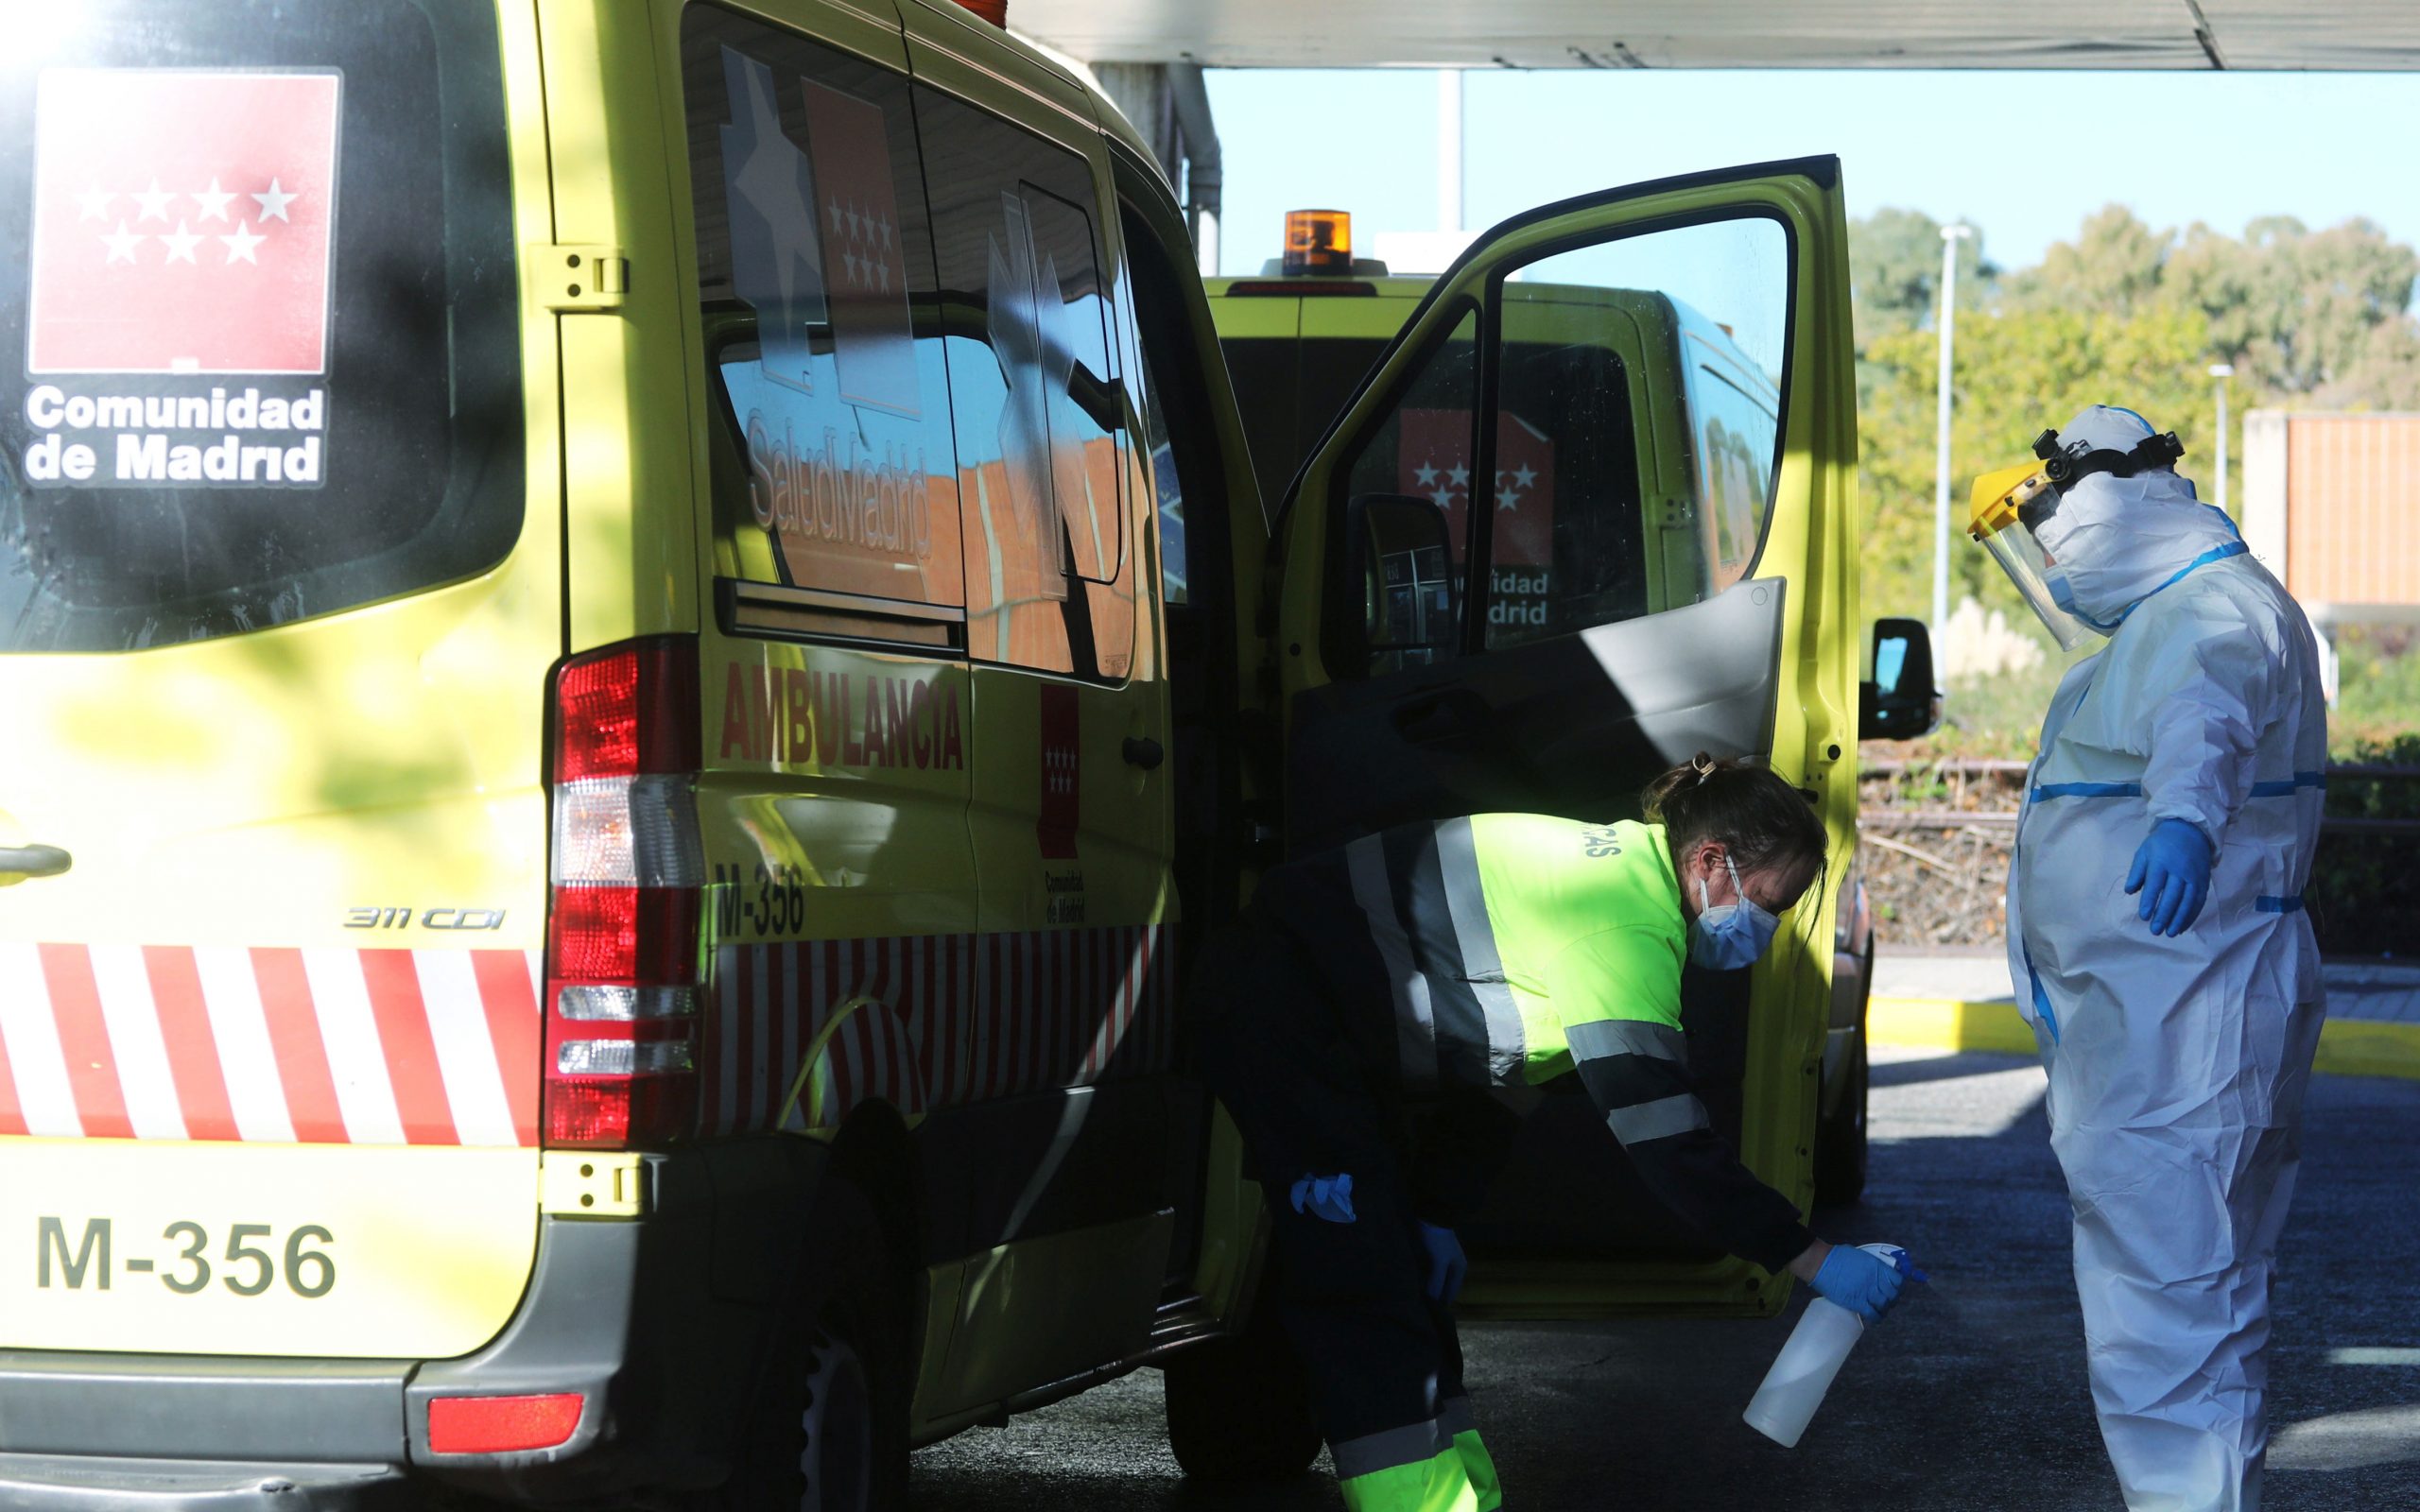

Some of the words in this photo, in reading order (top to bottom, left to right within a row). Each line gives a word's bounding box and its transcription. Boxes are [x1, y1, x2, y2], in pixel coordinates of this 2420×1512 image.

[26, 385, 323, 430] Comunidad
[26, 434, 96, 480] de
[115, 434, 320, 481] Madrid
[719, 661, 963, 771] AMBULANCIA
[1582, 827, 1621, 857] CAS
[343, 907, 412, 929] 311
[422, 907, 506, 930] CDI
[716, 861, 804, 936] M-356
[38, 1216, 336, 1298] M-356
